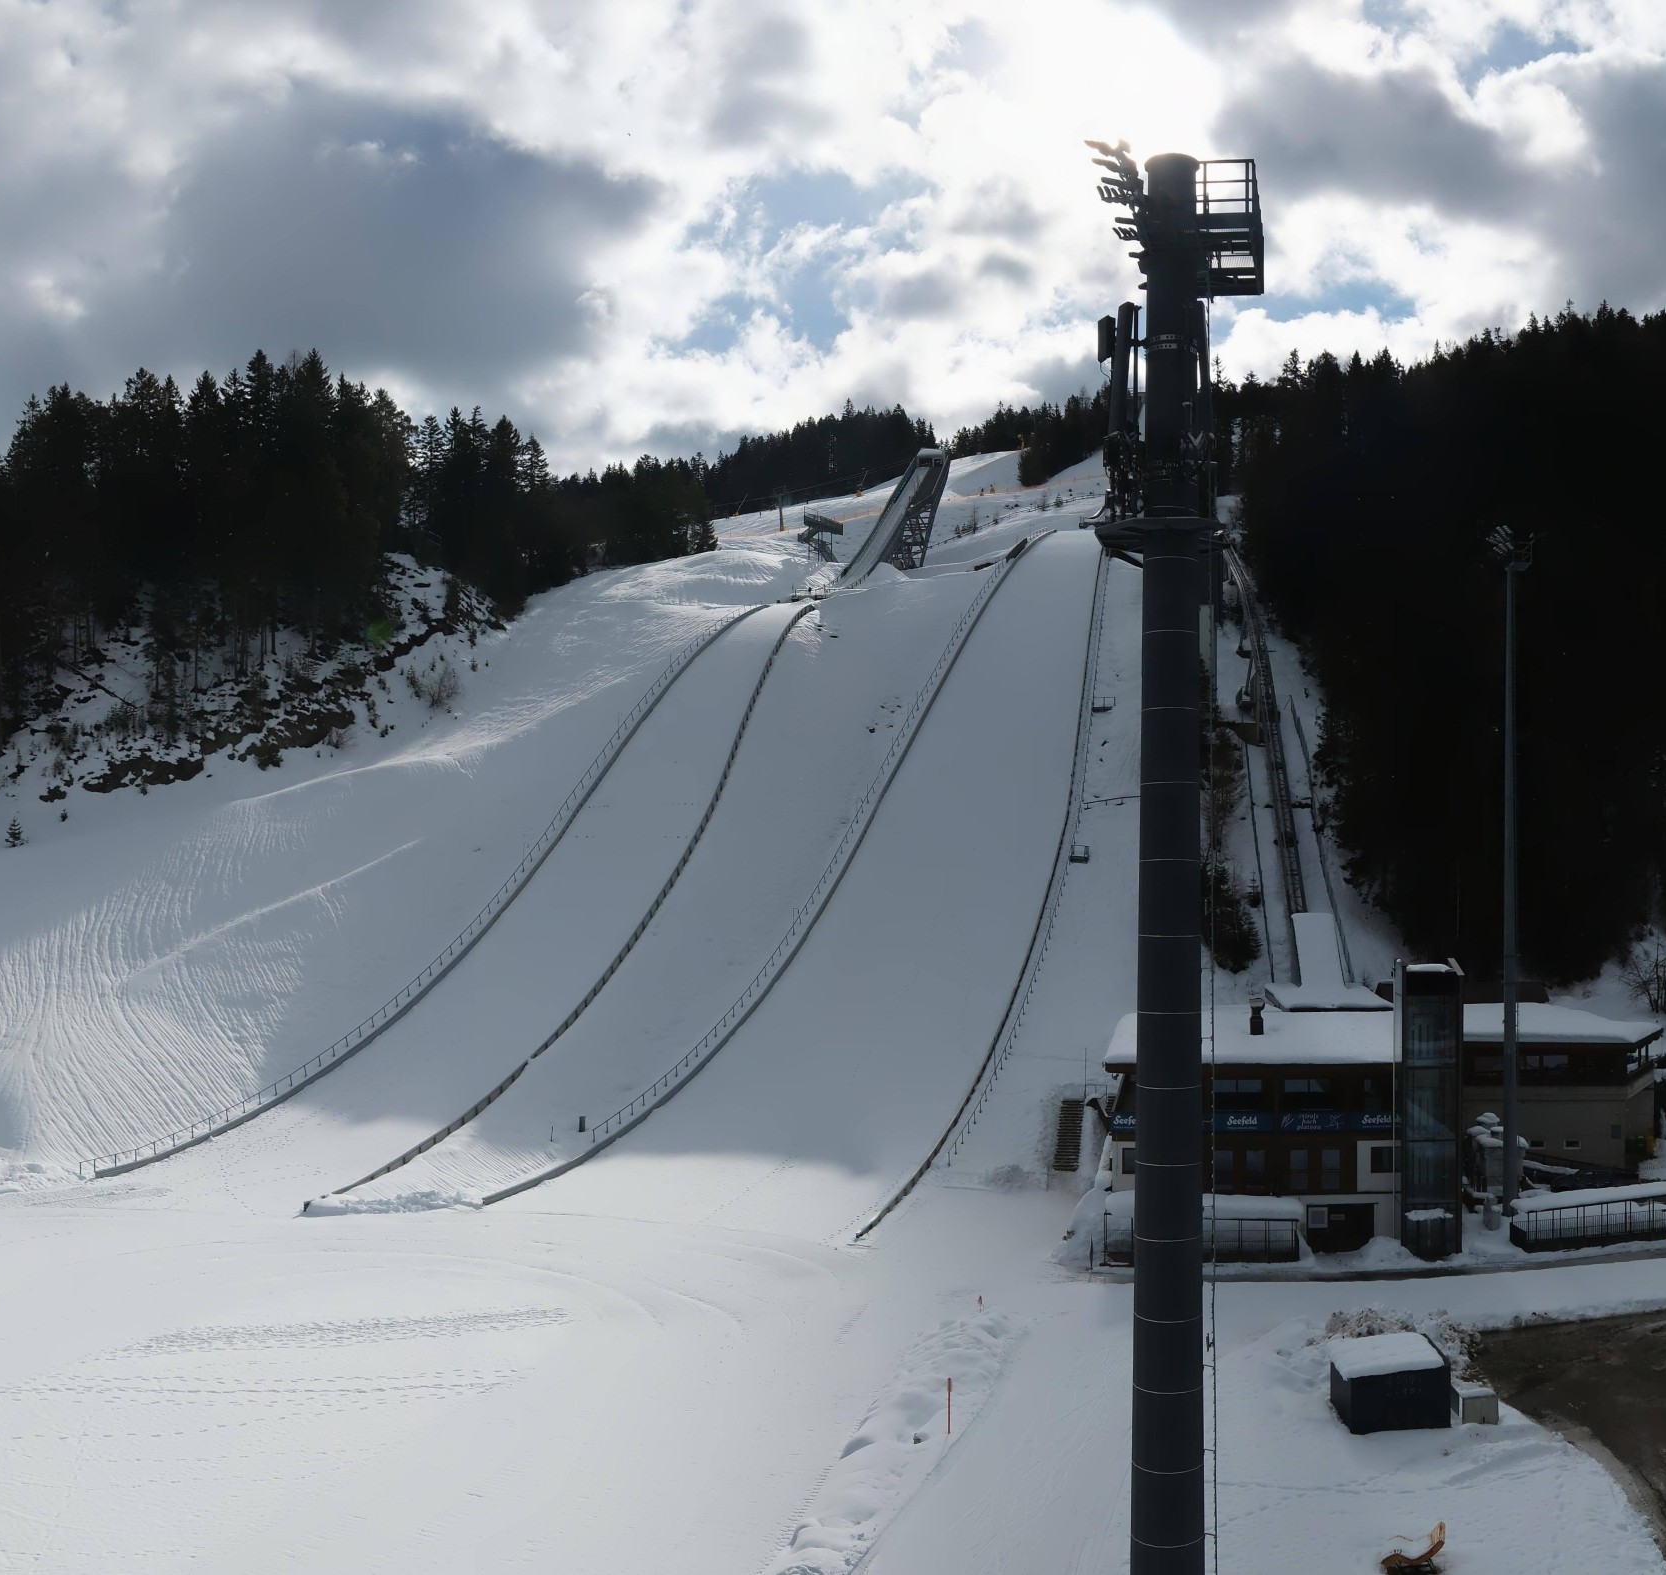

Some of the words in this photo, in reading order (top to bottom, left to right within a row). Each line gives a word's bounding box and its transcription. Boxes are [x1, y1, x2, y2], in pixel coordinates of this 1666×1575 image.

[1113, 1115, 1137, 1126] Seefe
[1226, 1115, 1258, 1126] Seefeld
[1361, 1114, 1392, 1125] Seefeld
